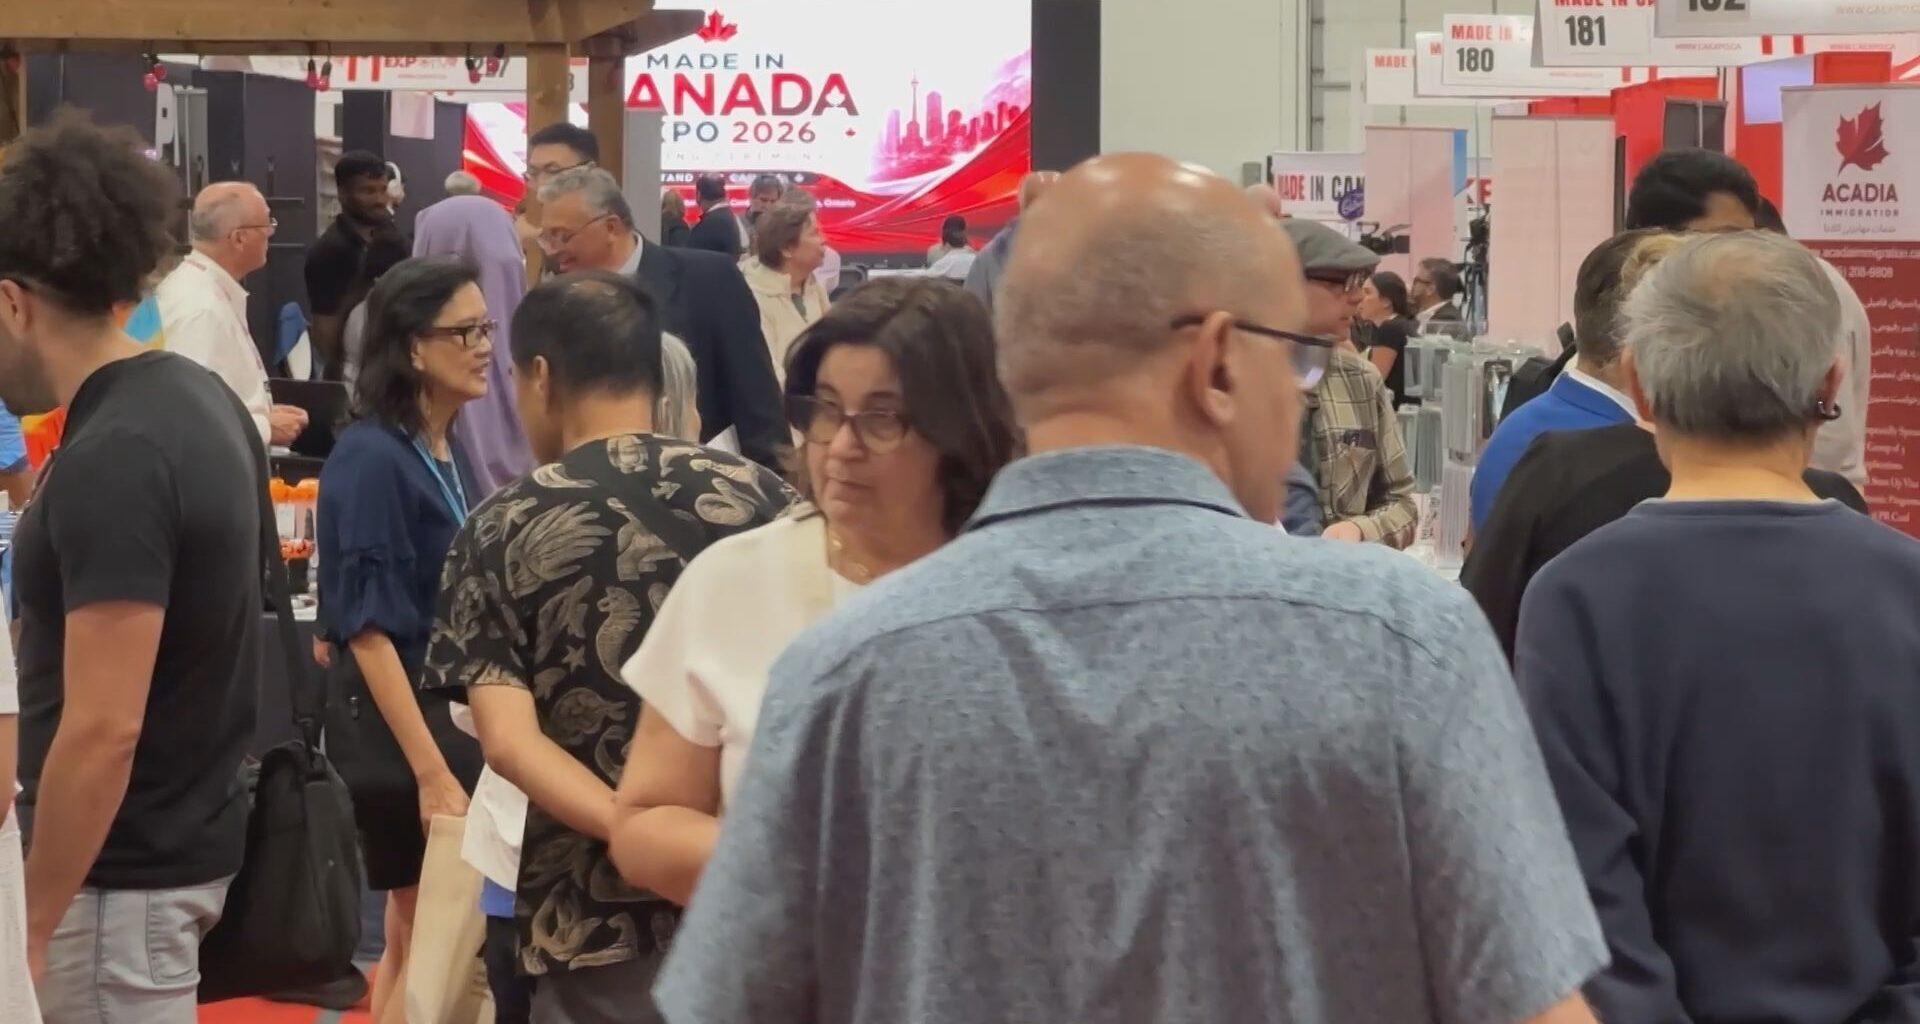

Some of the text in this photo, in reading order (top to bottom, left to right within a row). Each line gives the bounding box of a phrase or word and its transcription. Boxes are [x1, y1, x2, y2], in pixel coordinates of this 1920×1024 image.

[1451, 24, 1493, 40] MADE
[1499, 25, 1513, 41] IN
[1565, 15, 1606, 46] 181
[646, 53, 784, 70] MADE IN
[1374, 55, 1407, 68] MADE
[1456, 47, 1494, 72] 180
[625, 73, 859, 116] ANADA
[731, 121, 816, 143] 2026
[1311, 176, 1324, 201] IN
[1822, 183, 1898, 202] ACADIA
[1820, 208, 1899, 217] IMMIGRATION
